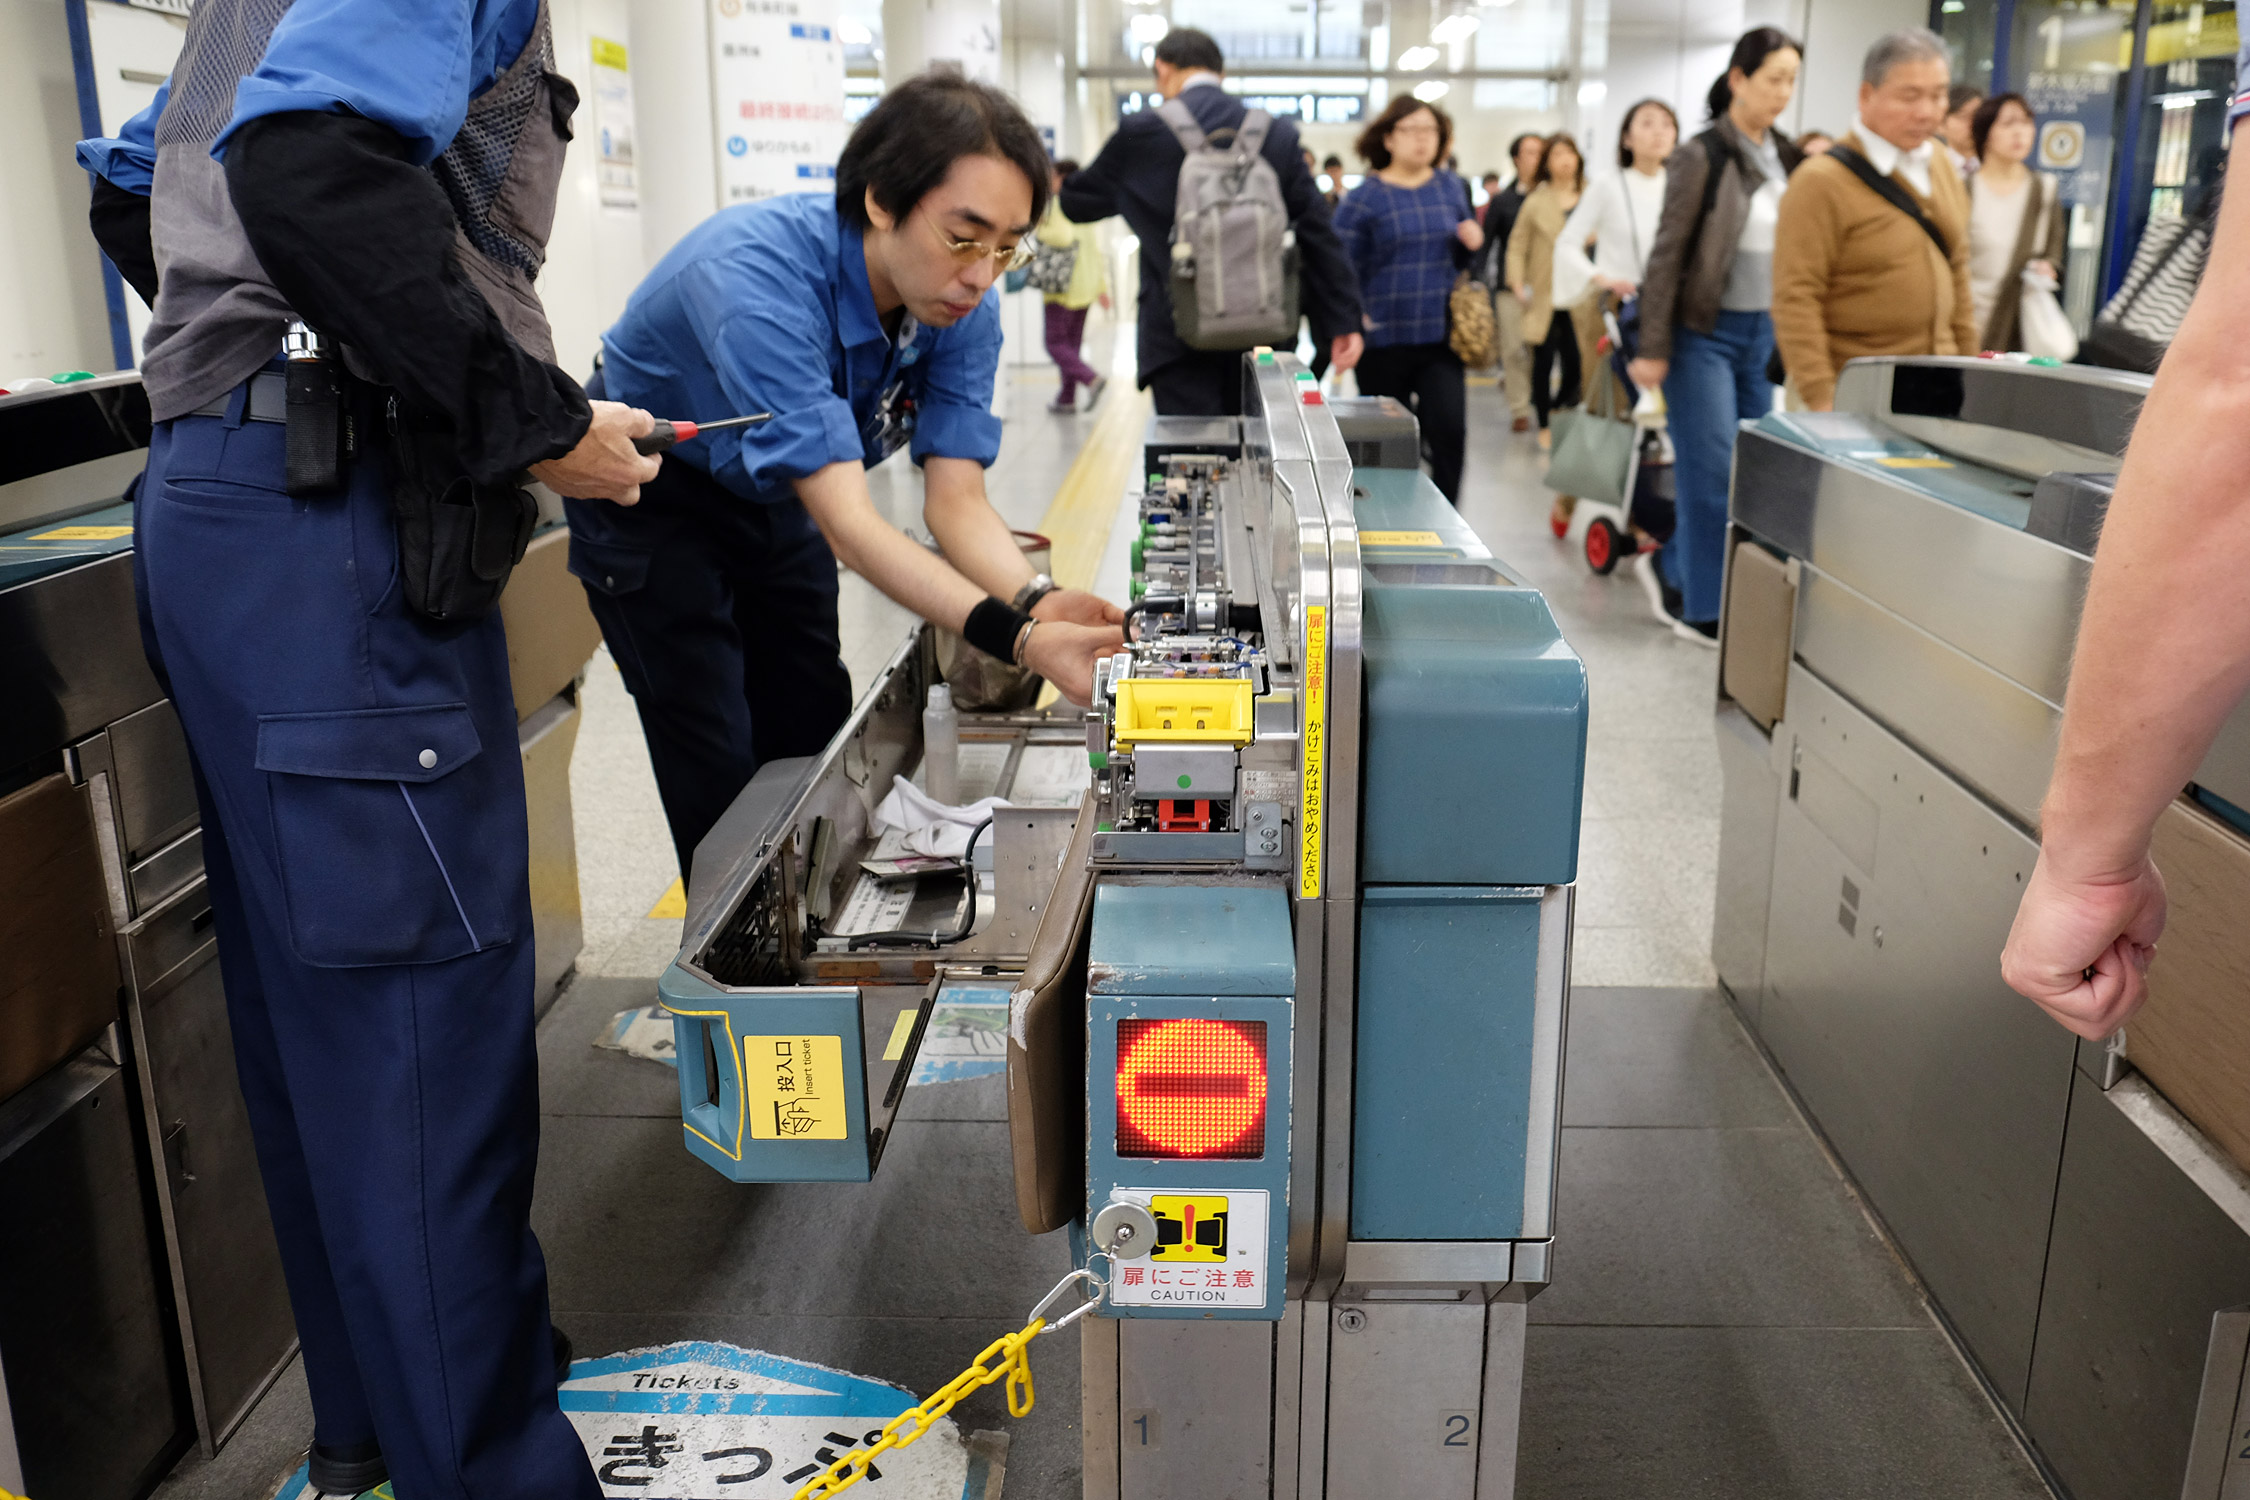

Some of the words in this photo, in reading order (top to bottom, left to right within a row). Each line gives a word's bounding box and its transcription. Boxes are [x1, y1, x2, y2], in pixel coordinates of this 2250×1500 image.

[2037, 15, 2062, 69] 1
[1303, 720, 1322, 890] かけこみはおやめください
[776, 1041, 796, 1092] 投入口
[802, 1038, 812, 1066] ticket
[804, 1068, 814, 1095] Insert
[1122, 1267, 1255, 1288] 扉にご注意
[1151, 1290, 1225, 1301] CAUTION
[1133, 1414, 1147, 1445] 1
[1443, 1414, 1470, 1446] 2
